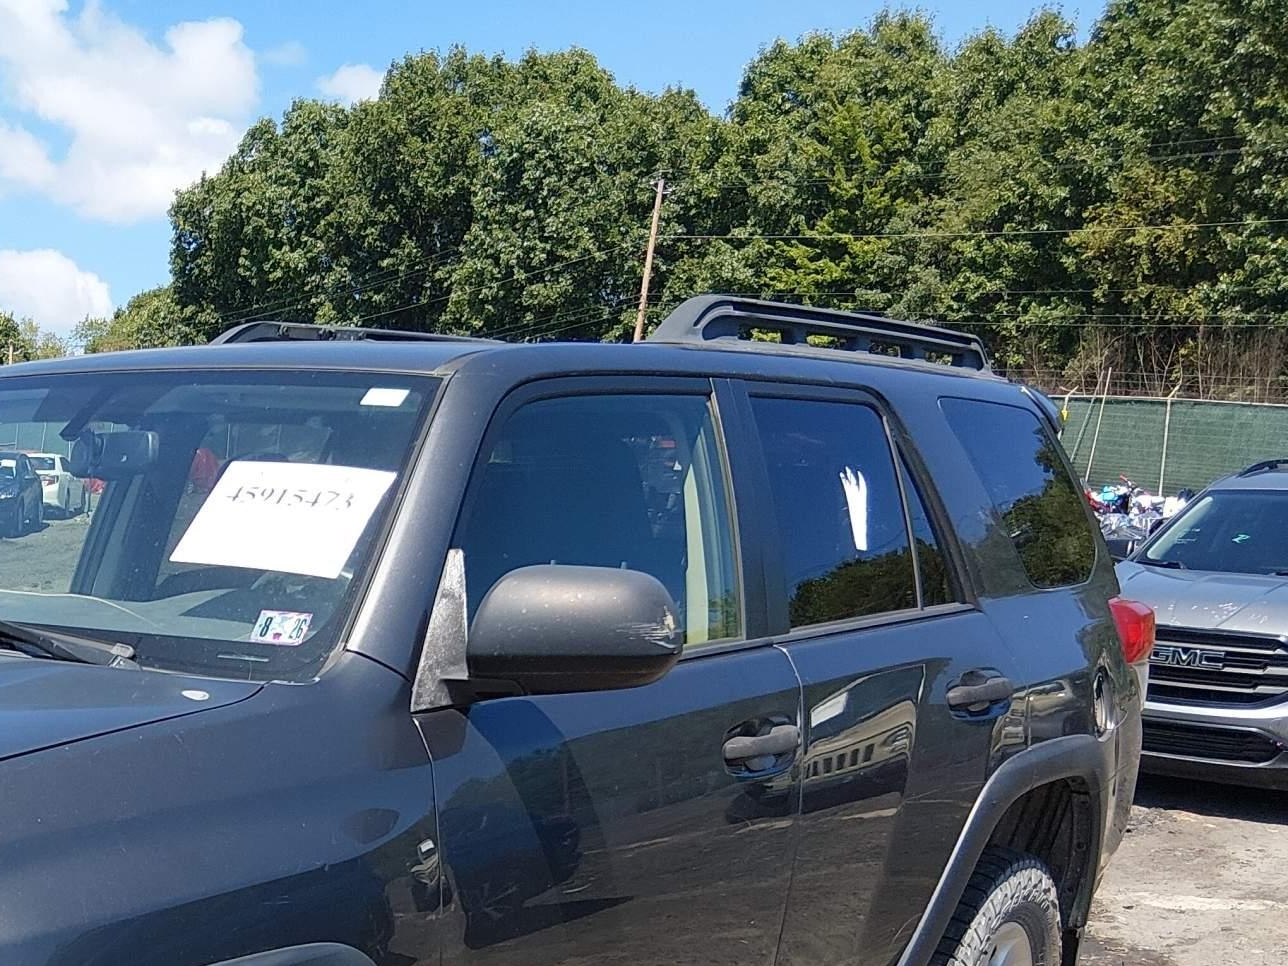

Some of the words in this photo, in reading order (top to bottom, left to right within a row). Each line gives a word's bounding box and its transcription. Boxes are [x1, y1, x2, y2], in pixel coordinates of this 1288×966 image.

[225, 486, 355, 511] 45915473
[259, 616, 273, 638] 8
[288, 618, 308, 640] 26
[1149, 645, 1226, 670] GMC
